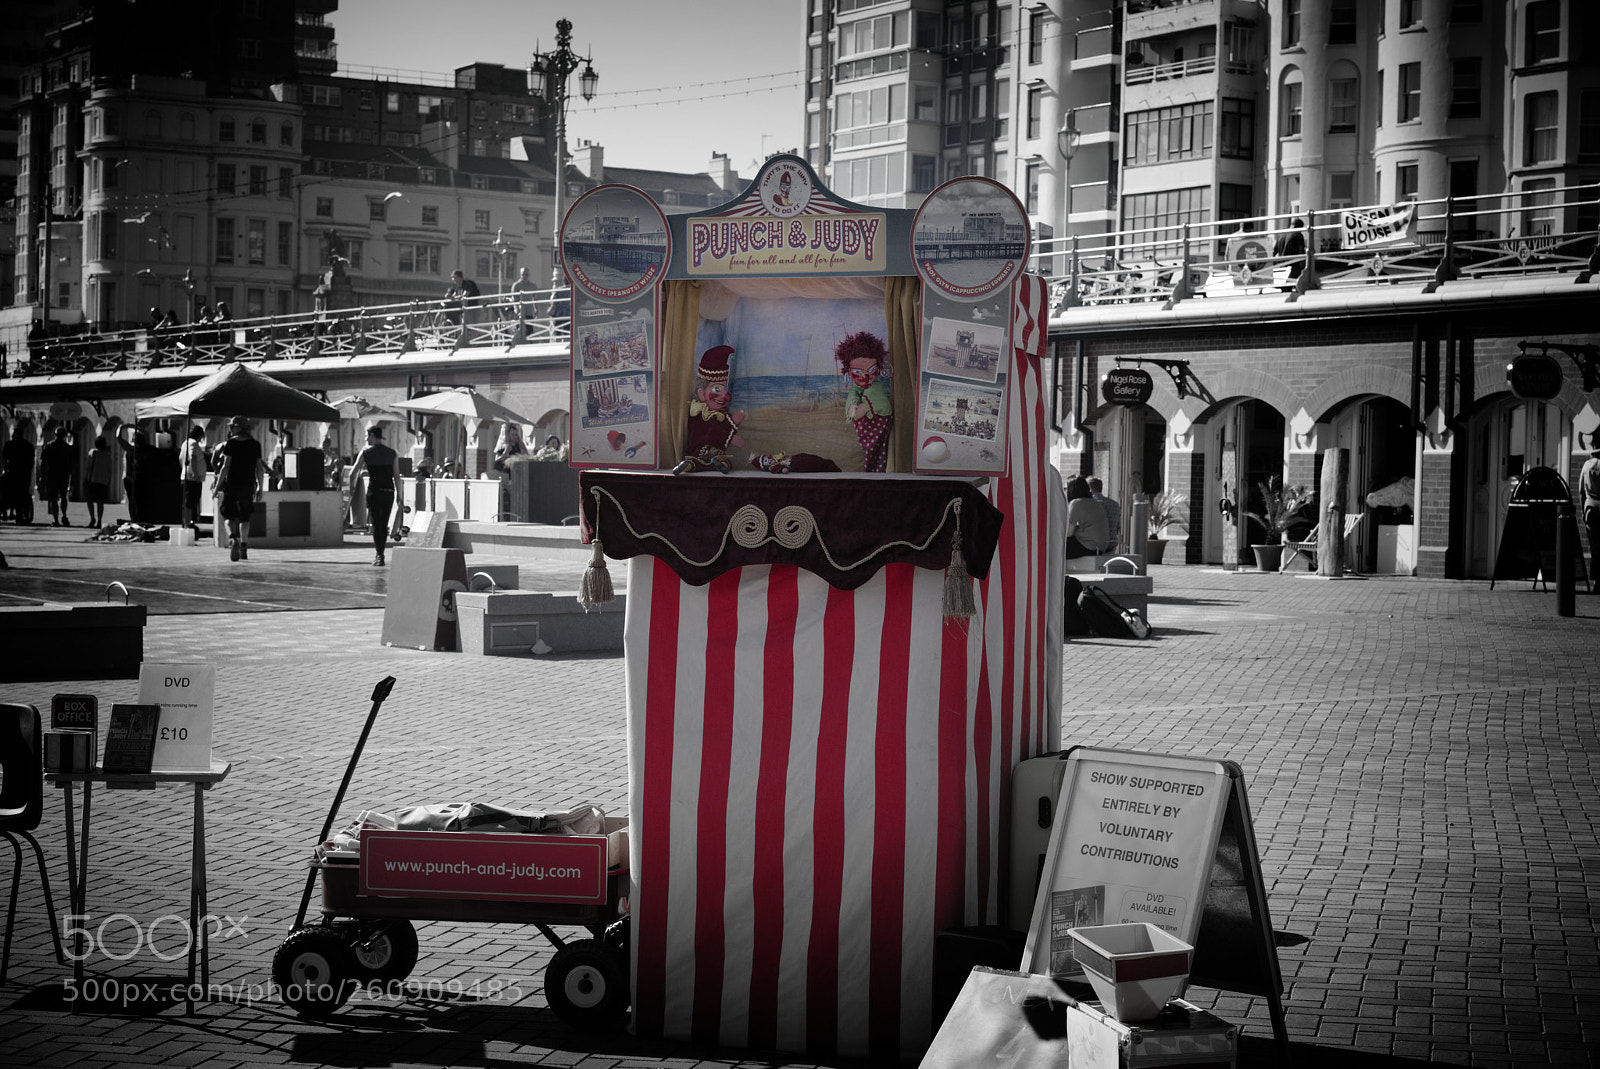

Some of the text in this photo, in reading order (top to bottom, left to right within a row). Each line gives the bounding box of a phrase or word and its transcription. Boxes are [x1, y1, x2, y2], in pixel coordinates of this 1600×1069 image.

[763, 164, 808, 187] THAT'S THE WAY
[771, 204, 780, 213] TO
[793, 202, 800, 211] IT
[692, 218, 880, 267] PUNCH & JUDY
[1347, 225, 1391, 246] HOUSE
[747, 255, 761, 269] for
[762, 254, 778, 265] all
[779, 253, 797, 265] and
[798, 253, 813, 265] all
[814, 253, 829, 268] for
[829, 253, 847, 268] fun
[587, 281, 606, 295] KATEY
[607, 284, 640, 297] (PEANUTS)
[639, 267, 655, 286] WILDE
[935, 277, 949, 289] GLYN
[949, 282, 992, 295] (CAPPUCCINO)
[991, 262, 1013, 287] EDWARDS
[1110, 375, 1147, 386] Nigel Rose
[1113, 385, 1142, 397] Gallery
[164, 677, 191, 688] DVD
[64, 701, 87, 711] BOX
[57, 711, 92, 722] OFFICE
[160, 727, 188, 740] £10
[1090, 771, 1205, 797] SHOW SUPPORTED
[1102, 797, 1181, 818] ENTIRELY BY
[1099, 821, 1174, 843] VOLUNTARY
[1080, 844, 1179, 869] CONTRIBUTIONS
[384, 860, 581, 881] www.punch-and-judy.com
[1146, 893, 1165, 903] DVD
[1130, 902, 1177, 916] AVAILABLE!
[1052, 921, 1074, 931] PUNCH
[1164, 923, 1178, 932] time
